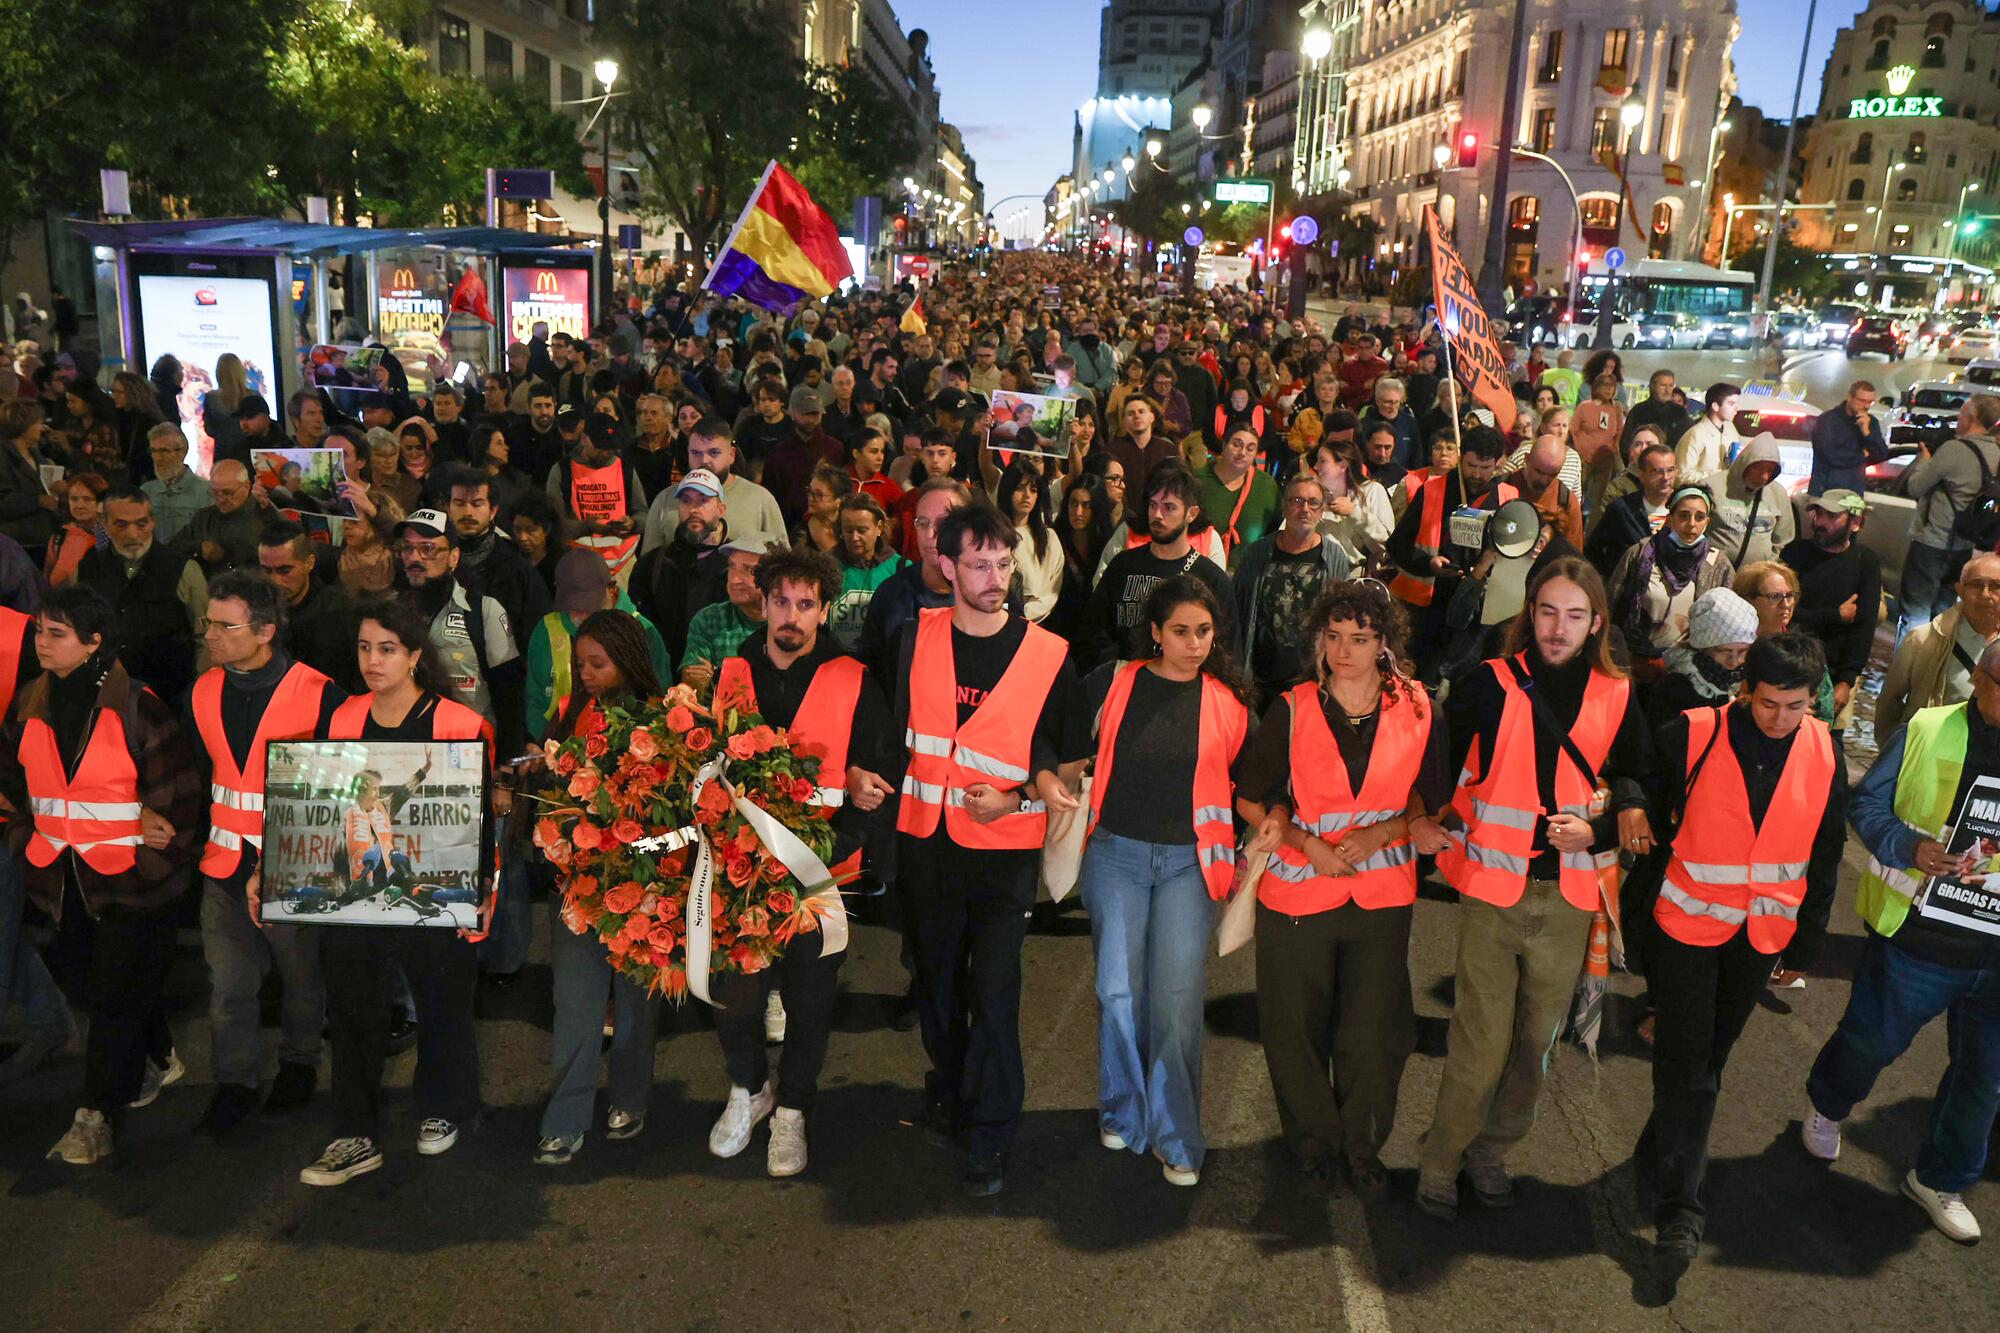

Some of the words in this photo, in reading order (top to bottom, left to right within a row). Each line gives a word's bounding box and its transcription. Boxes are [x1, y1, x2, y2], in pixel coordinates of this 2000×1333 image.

[1848, 96, 1944, 119] ROLEX
[511, 301, 584, 319] INTENSE
[305, 804, 341, 827] VIDA
[409, 803, 472, 827] BARRIO
[694, 864, 709, 928] Seguiremos
[1937, 882, 1988, 909] GRACIAS
